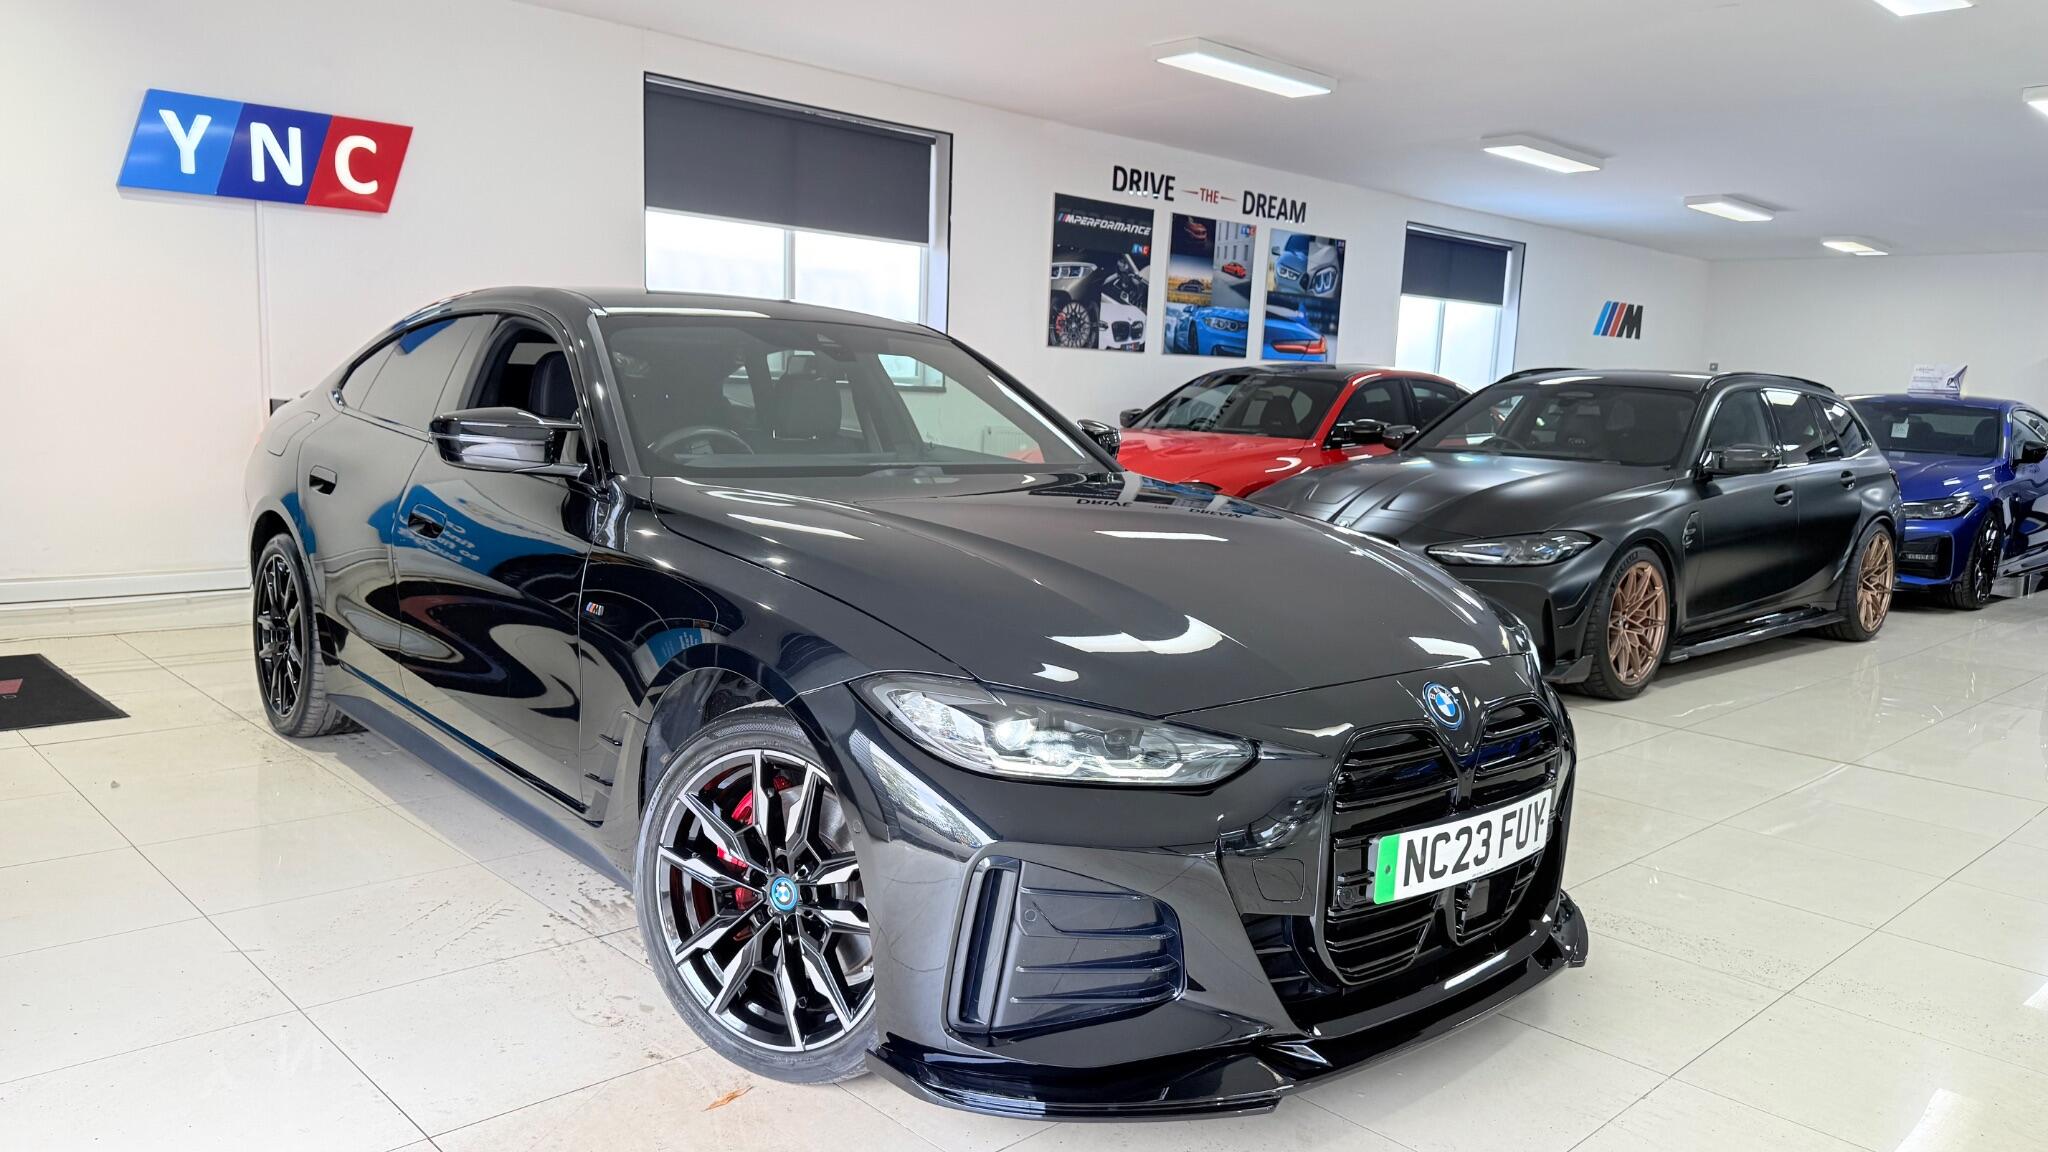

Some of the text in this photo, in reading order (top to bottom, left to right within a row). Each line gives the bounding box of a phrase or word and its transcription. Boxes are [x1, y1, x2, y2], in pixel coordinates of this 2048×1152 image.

[158, 108, 379, 195] YNC
[1111, 165, 1307, 224] DRIVE THE DREAM
[1616, 303, 1643, 339] M
[1403, 796, 1547, 888] NC23 FUY
